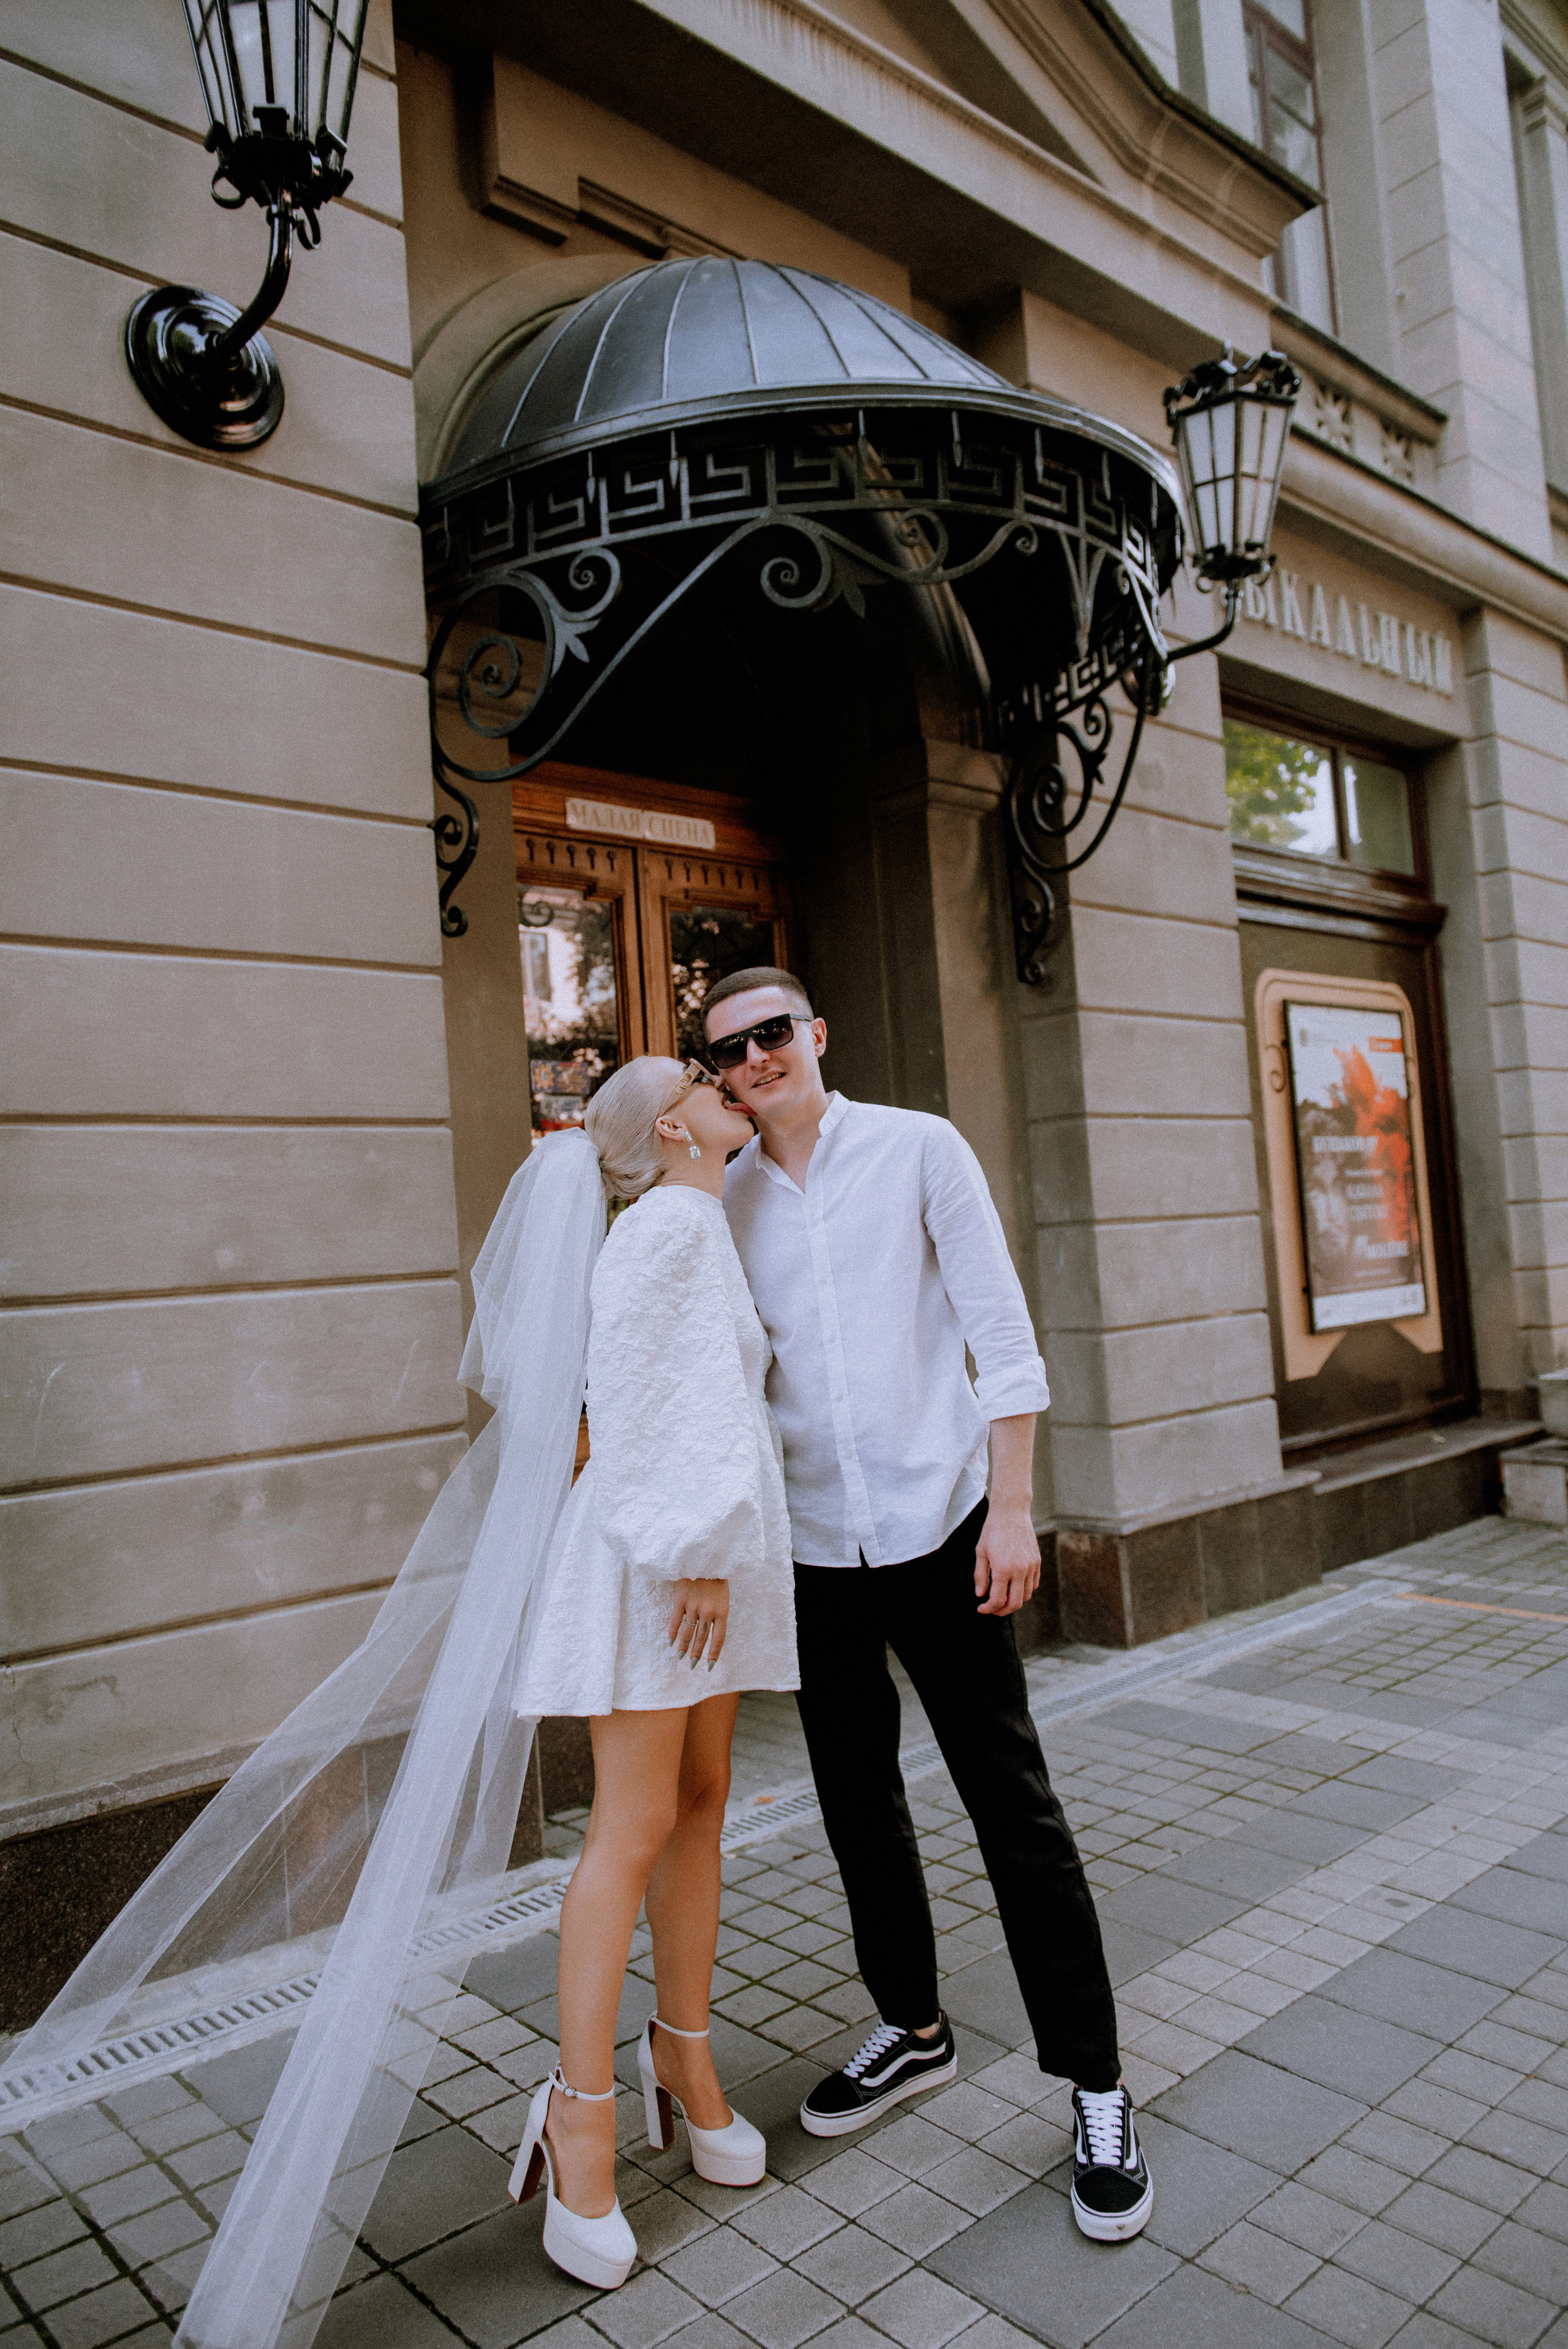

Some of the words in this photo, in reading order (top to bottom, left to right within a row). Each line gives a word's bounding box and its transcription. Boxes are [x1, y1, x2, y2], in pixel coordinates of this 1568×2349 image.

[1219, 567, 1453, 695] ЫКАЛЬНЫЙ
[570, 802, 641, 832] МАЛАЯ
[647, 815, 710, 844] СЦЕНА
